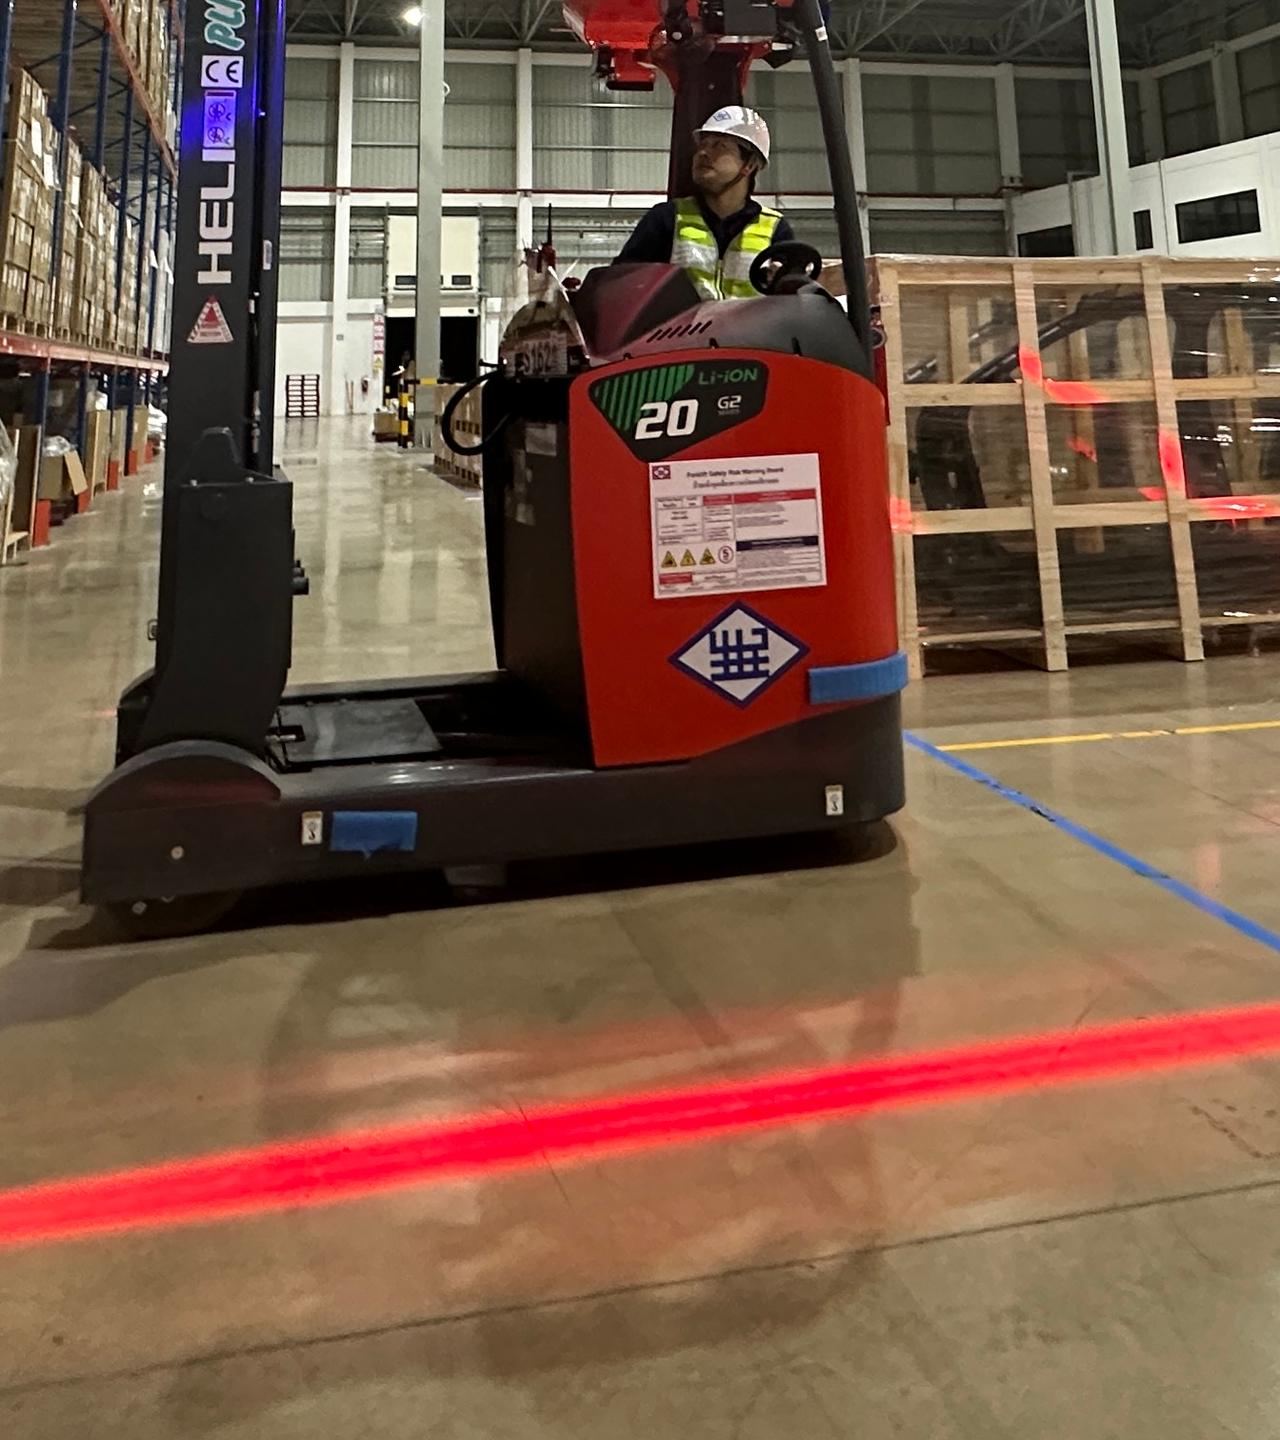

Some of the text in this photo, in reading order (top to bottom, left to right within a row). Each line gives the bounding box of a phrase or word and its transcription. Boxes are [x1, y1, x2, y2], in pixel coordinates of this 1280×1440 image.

[205, 60, 240, 84] CE
[197, 148, 236, 285] HELI
[634, 394, 742, 440] 20 G2
